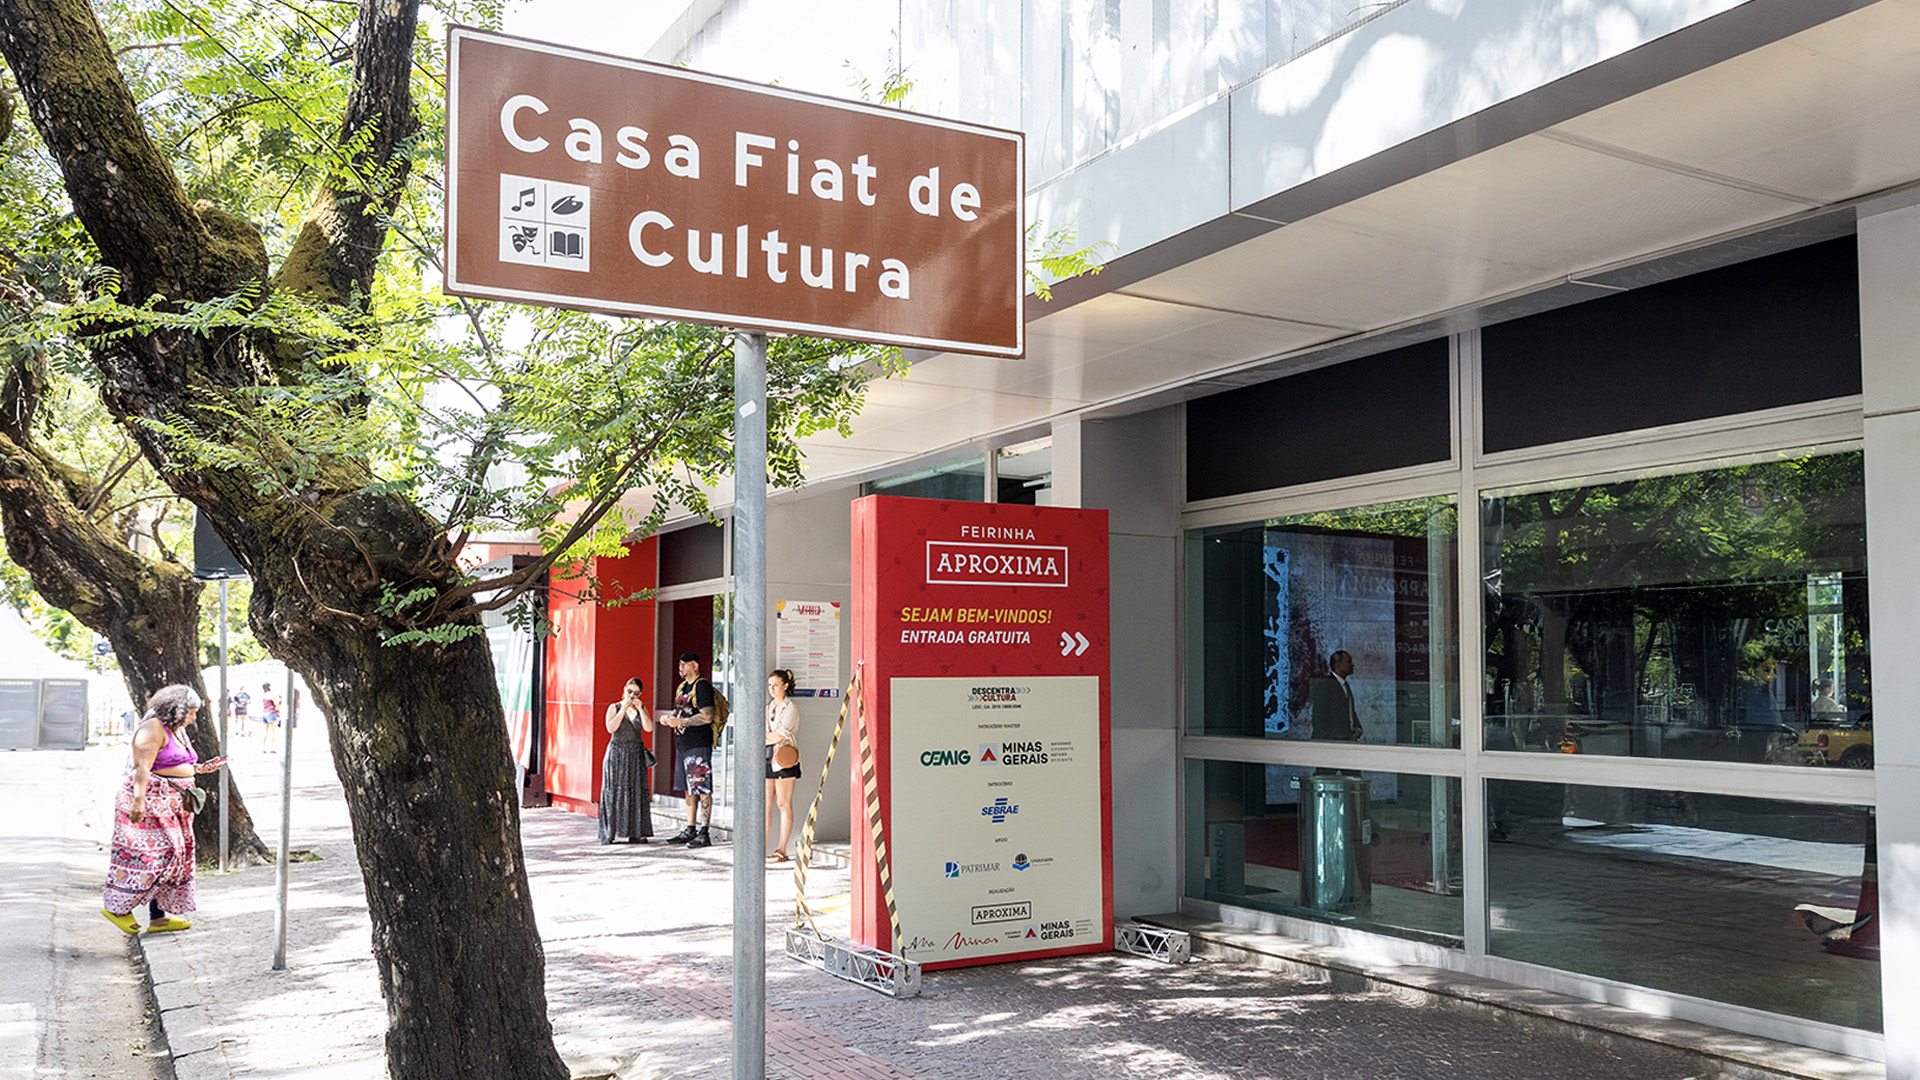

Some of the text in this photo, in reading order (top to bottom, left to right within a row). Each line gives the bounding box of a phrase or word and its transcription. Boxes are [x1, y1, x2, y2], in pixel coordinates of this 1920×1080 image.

[499, 93, 982, 222] Casa Fiat de
[627, 210, 911, 300] Cultura
[960, 525, 1036, 541] FEIRINHA
[936, 552, 1060, 577] APROXIMA
[899, 606, 1053, 625] SEJAM BEM-VINDOS!
[1764, 618, 1807, 633] CASA
[899, 629, 1032, 645] ENTRADA GRATUITA
[972, 687, 1016, 695] DESCENTRA
[982, 694, 1017, 702] CULTURA
[1002, 741, 1042, 753] MINAS
[920, 749, 972, 767] CEMIG
[1002, 753, 1048, 765] GERAIS
[981, 805, 1019, 816] SEBRAE
[961, 863, 1000, 874] PATRIMAR
[975, 906, 1028, 920] APROXIMA
[1040, 920, 1070, 931] MINAS
[1040, 929, 1074, 941] GERAIS
